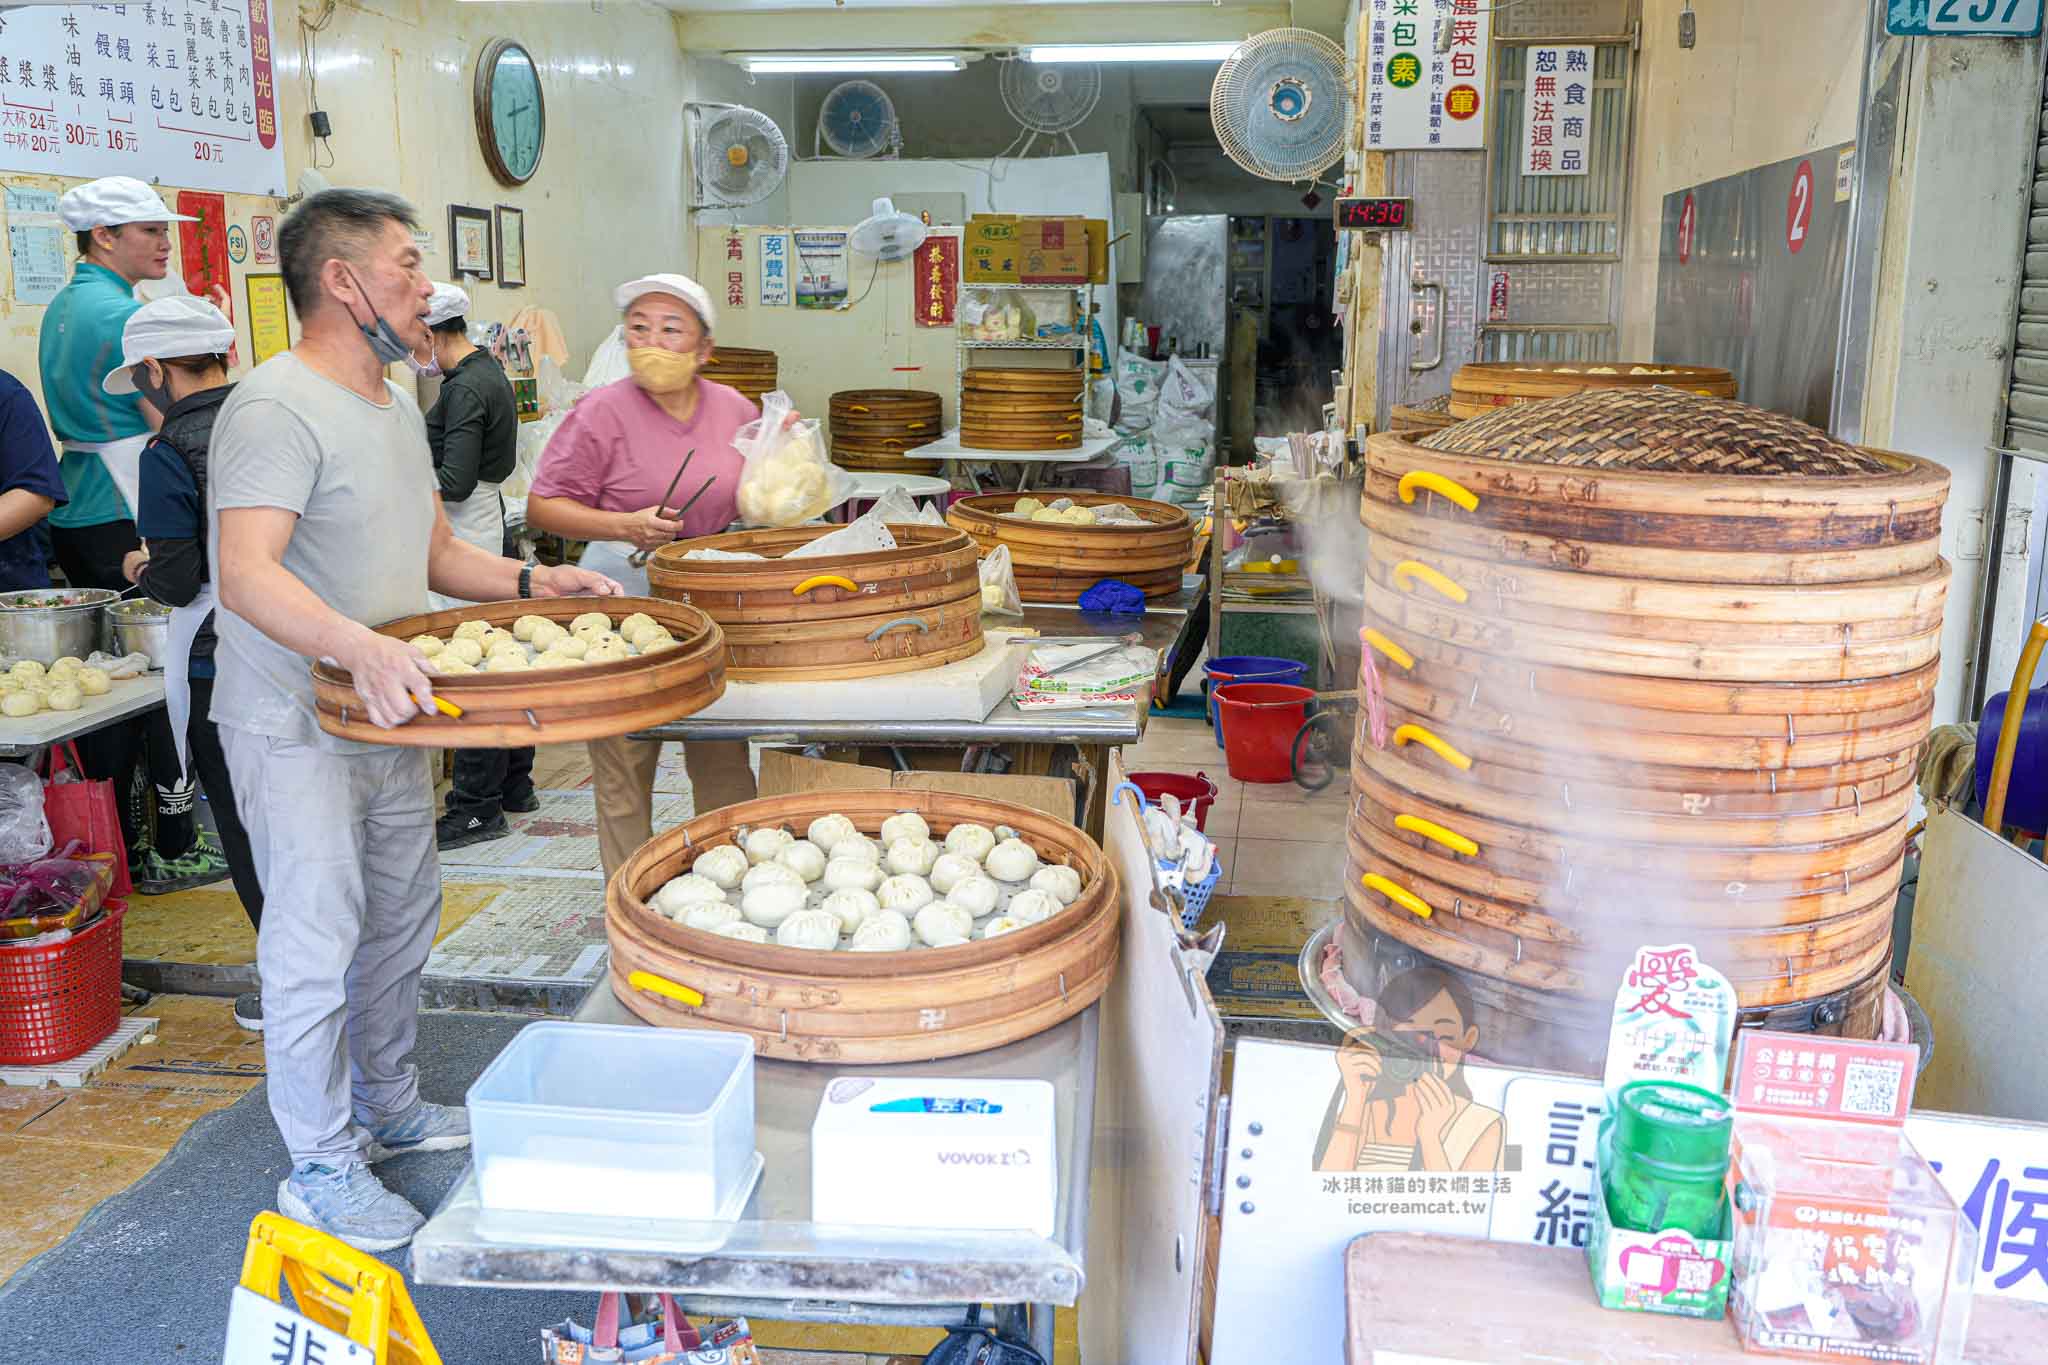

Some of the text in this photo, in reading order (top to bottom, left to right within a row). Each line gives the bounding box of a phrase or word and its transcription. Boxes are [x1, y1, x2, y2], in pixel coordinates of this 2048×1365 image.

[95, 3, 116, 101] 饅頭
[1391, 57, 1417, 83] 素
[1451, 90, 1475, 114] 葷
[1530, 50, 1557, 171] 恕無法退換
[1561, 49, 1588, 170] 熟食商品
[1348, 202, 1406, 224] 14:30
[1683, 204, 1692, 256] 1
[1790, 174, 1808, 241] 2
[230, 236, 244, 249] FSI
[765, 237, 783, 278] 免費
